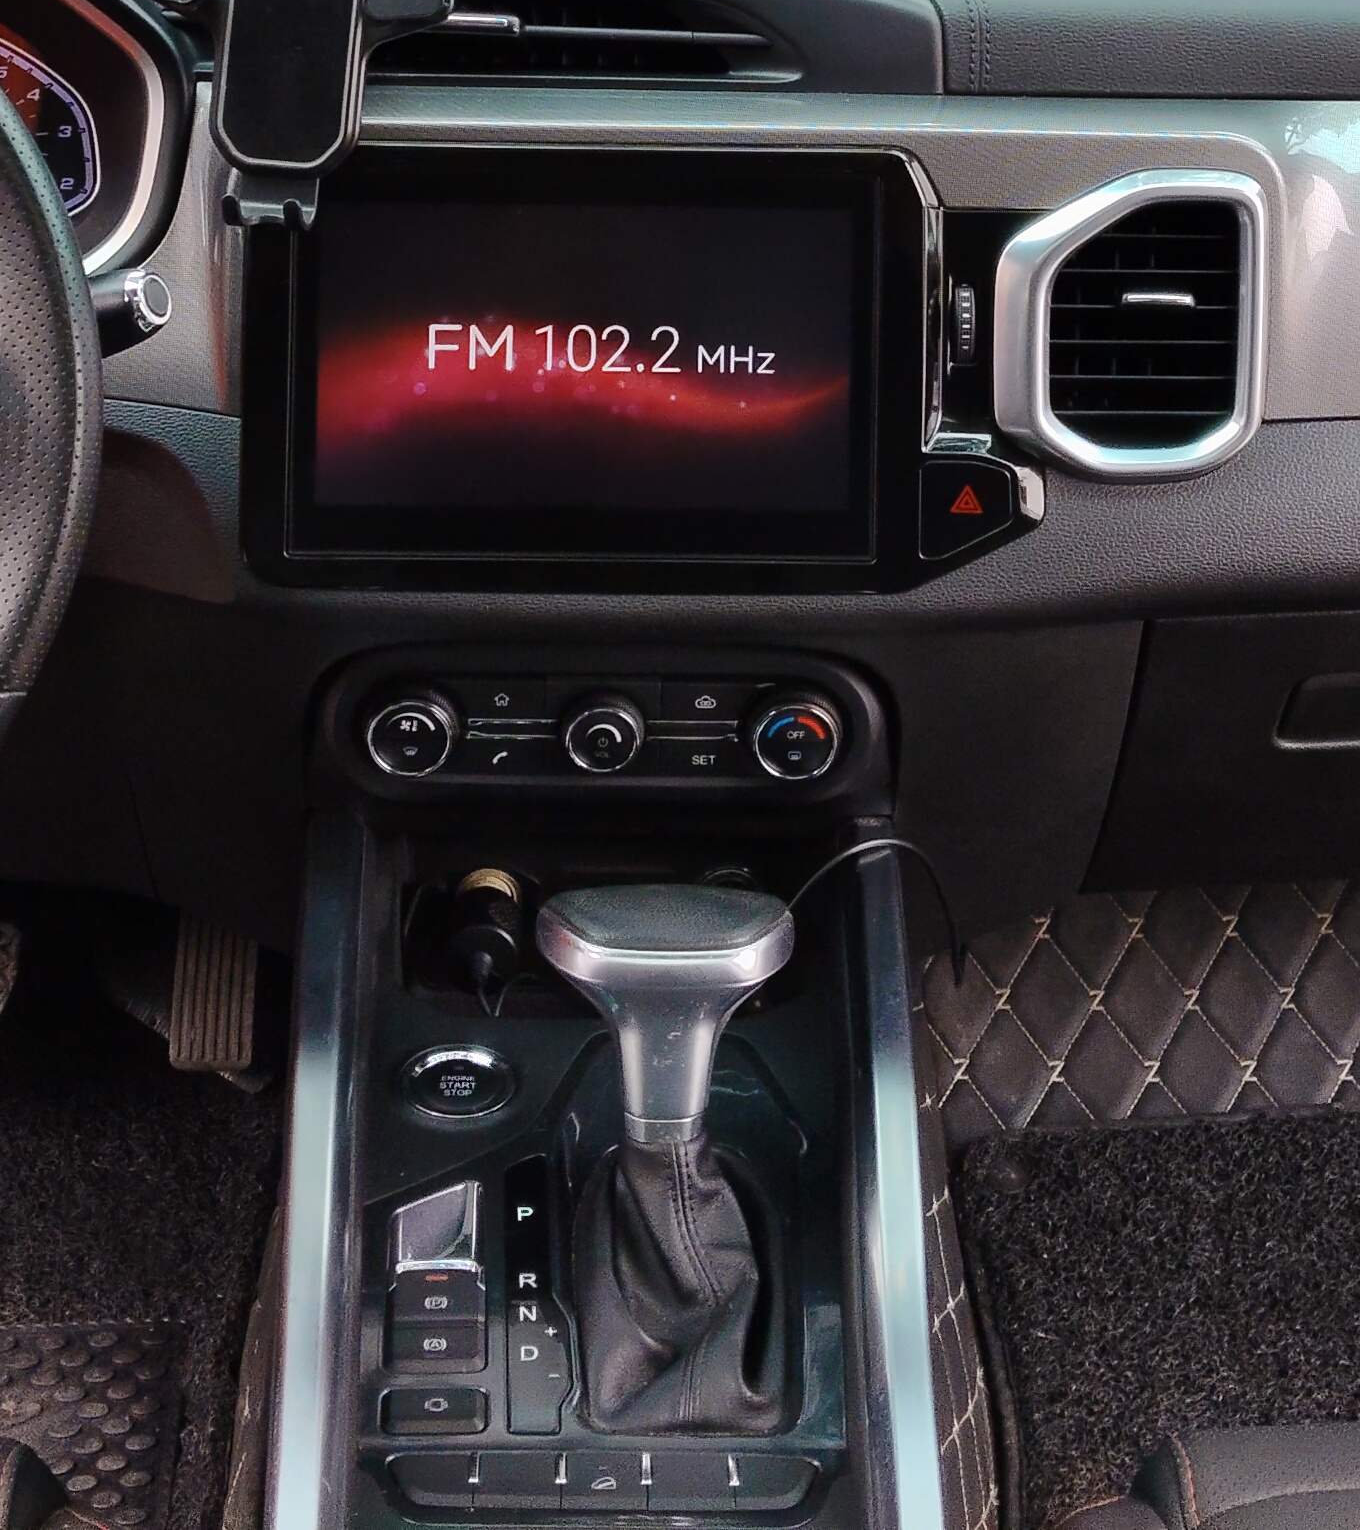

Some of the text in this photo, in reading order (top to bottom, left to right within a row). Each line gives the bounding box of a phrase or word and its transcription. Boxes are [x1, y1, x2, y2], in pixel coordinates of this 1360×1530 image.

[26, 88, 40, 101] 4
[57, 125, 72, 137] 3
[59, 177, 74, 190] 2
[428, 323, 776, 374] FM 102.2 MHz
[786, 730, 805, 740] OFF
[691, 755, 716, 766] SET
[439, 1081, 477, 1089] START
[443, 1089, 473, 1097] STOP
[517, 1206, 534, 1221] P
[518, 1273, 538, 1289] R
[519, 1305, 537, 1322] N
[520, 1345, 539, 1362] D
